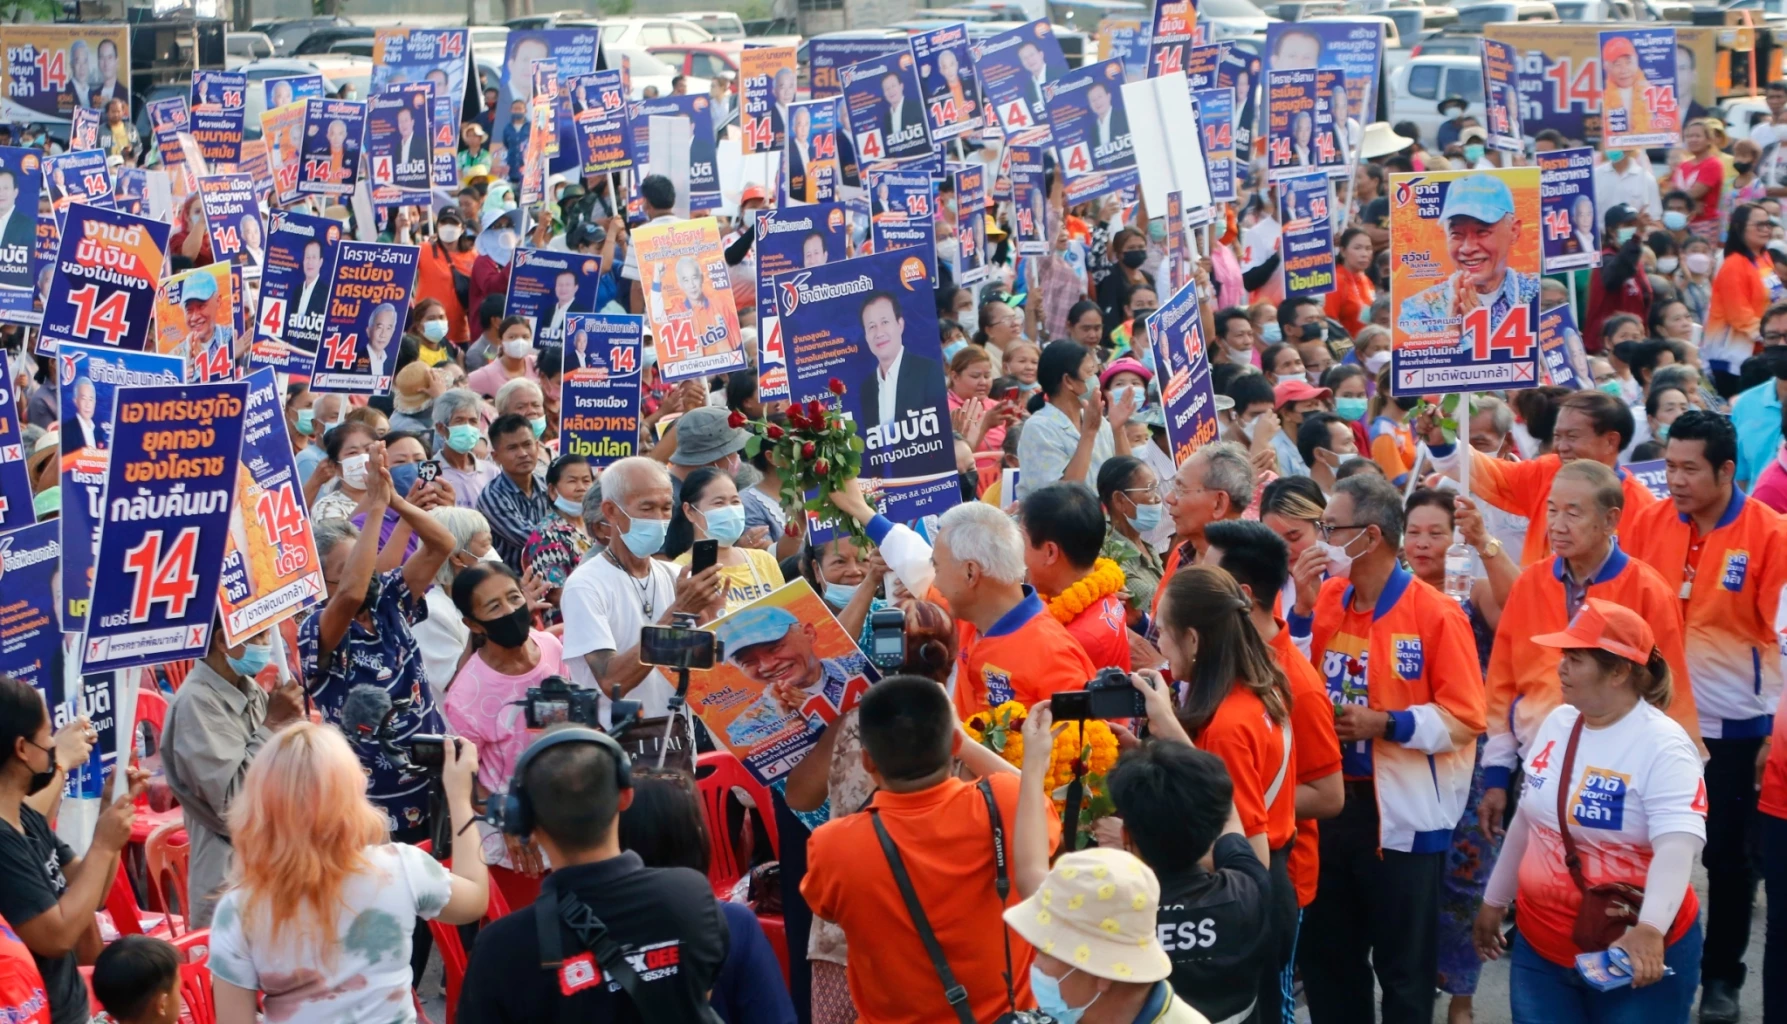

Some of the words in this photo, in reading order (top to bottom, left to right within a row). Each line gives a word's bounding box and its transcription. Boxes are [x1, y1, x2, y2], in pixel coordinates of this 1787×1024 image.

[1161, 2, 1187, 15] งานดี
[1158, 17, 1186, 33] มีเงิน
[8, 43, 33, 62] ชาติ
[436, 30, 464, 58] 14
[35, 49, 67, 91] 14
[1155, 45, 1184, 76] 14
[8, 77, 34, 97] กล้า
[744, 75, 767, 88] ชาติ
[1546, 56, 1601, 113] 14
[223, 91, 242, 107] 14
[602, 91, 621, 109] 14
[744, 97, 768, 112] กล้า
[1270, 98, 1314, 114] เศรษฐกิจ
[1643, 85, 1678, 113] 14
[931, 98, 959, 126] 14
[1007, 102, 1027, 127] 4
[744, 116, 774, 150] 14
[886, 124, 924, 147] สมบัติ
[1204, 123, 1232, 149] 14
[813, 133, 835, 158] 14
[862, 132, 881, 158] 4
[1270, 137, 1292, 166] 14
[1317, 131, 1335, 164] 14
[305, 160, 331, 182] 14
[376, 157, 391, 182] 4
[396, 158, 426, 176] สมบัติ
[690, 161, 714, 178] บัติ
[1068, 146, 1088, 173] 4
[84, 174, 107, 197] 14
[815, 184, 832, 199] กล้า
[1414, 181, 1439, 195] ชาติ
[203, 191, 252, 204] ผลิตอาหาร
[207, 202, 243, 216] ป้อนโลก
[906, 194, 928, 215] 14
[1310, 196, 1328, 218] 14
[1414, 196, 1440, 206] พัฒนา
[1417, 204, 1440, 218] กล้า
[83, 219, 143, 246] งานดี
[1546, 210, 1571, 240] 14
[213, 226, 242, 254] 14
[960, 227, 974, 258] 14
[76, 239, 137, 270] มีเงิน
[343, 245, 412, 265] โคราช-อีสาน
[1285, 252, 1332, 271] ผลิตอาหาร
[1401, 250, 1430, 265] สุวัจน์
[61, 260, 149, 290] ของไม่แพง
[339, 261, 394, 283] ระเบียง
[1289, 271, 1332, 291] ป้อนโลก
[336, 281, 405, 304] เศรษฐกิจ
[800, 275, 874, 305] ชาติพัฒนากล้า
[67, 283, 131, 347] 14
[263, 302, 281, 334] 4
[331, 299, 361, 318] ใหม่
[1422, 313, 1463, 326] พรรคเบอร์
[49, 322, 71, 335] เบอร์
[659, 319, 699, 358] 14
[766, 319, 784, 358] 4
[1463, 305, 1537, 360] 14
[323, 333, 358, 369] 14
[1183, 323, 1202, 365] 14
[1398, 345, 1464, 358] โคราชโนมิกส์
[194, 345, 233, 383] 14
[610, 346, 635, 372] 14
[680, 354, 729, 373] ชาติพัฒนากล้า
[1427, 367, 1510, 383] ชาติพัฒนากล้า
[121, 392, 242, 426] เอาเศรษฐกิจ
[574, 395, 628, 409] โคราชเมือง
[563, 415, 636, 432] ผลิตอาหาร
[866, 406, 941, 451] สมบัติ
[142, 427, 215, 459] ยุคทอง
[568, 435, 631, 457] ป้อนโลก
[870, 438, 944, 467] กาญจนวัฒนา
[124, 453, 225, 483] ของโคราช
[111, 482, 229, 523] กลับคืนมา
[256, 481, 304, 545] 14
[916, 498, 927, 507] เขต
[274, 544, 308, 578] เด้อ
[124, 527, 200, 624] 14
[227, 580, 247, 602] กล้า
[248, 584, 304, 623] ชาติพัฒนากล้า
[100, 609, 130, 628] เบอร์
[1396, 637, 1422, 651] ชาติ
[1396, 650, 1421, 660] พัฒนา
[1396, 660, 1419, 673] กล้า
[746, 728, 817, 763] โคราชโนมิกส์
[1530, 740, 1556, 774] 4
[1580, 787, 1613, 802] พัฒนา
[1585, 774, 1620, 792] ชาติ
[1573, 800, 1612, 821] กล้า
[995, 827, 1005, 868] Canon
[1157, 917, 1217, 952] ESS
[640, 965, 678, 982] 65244
